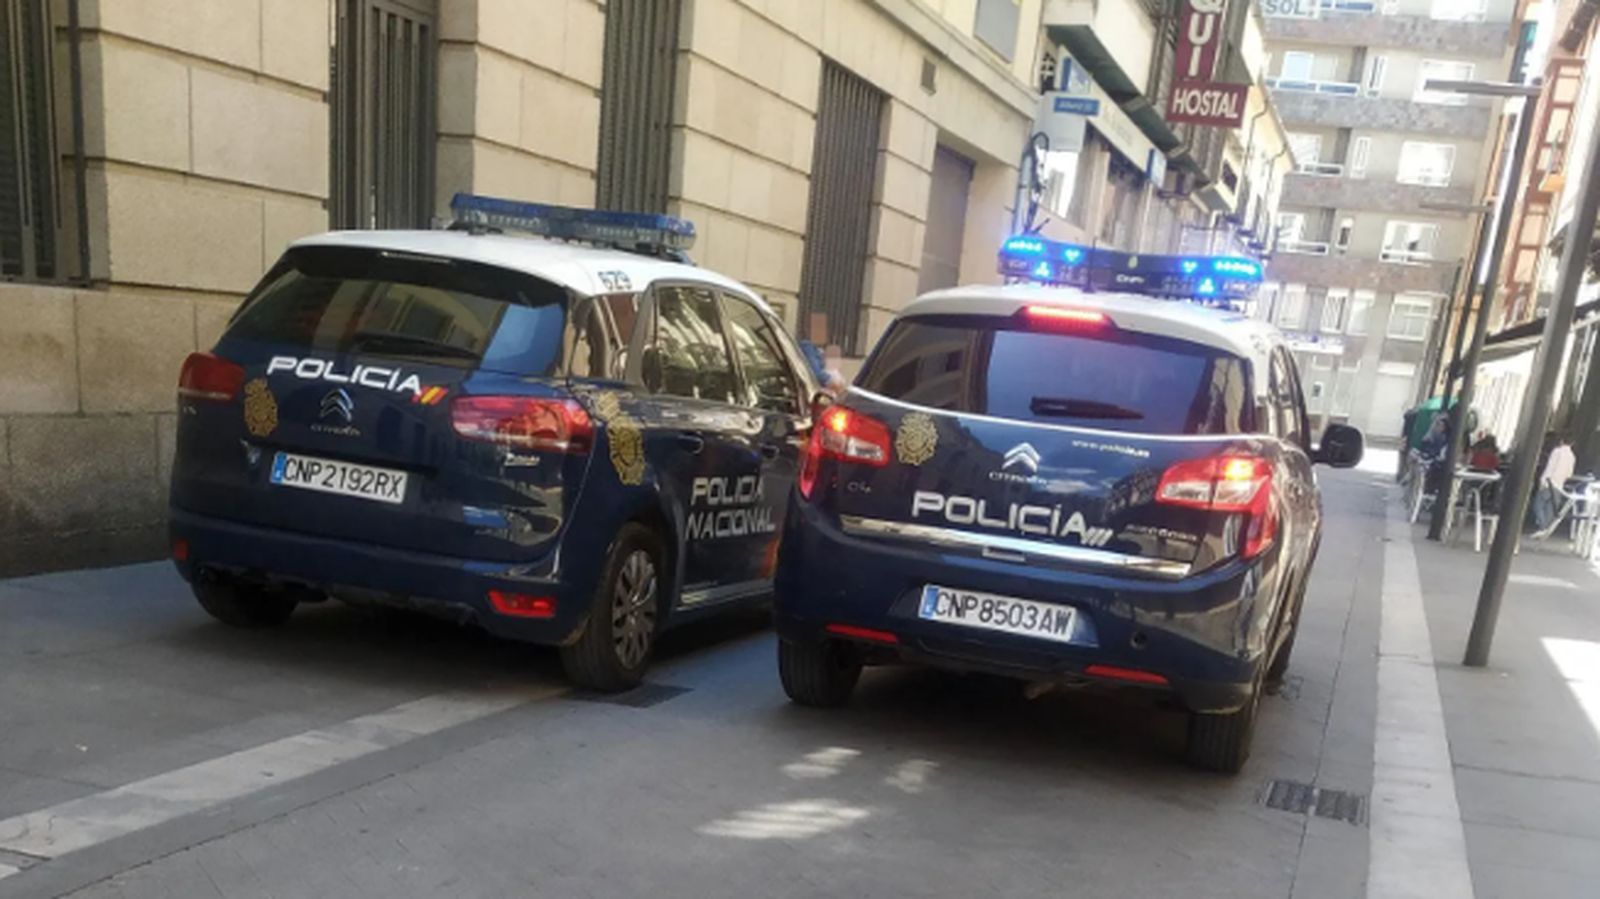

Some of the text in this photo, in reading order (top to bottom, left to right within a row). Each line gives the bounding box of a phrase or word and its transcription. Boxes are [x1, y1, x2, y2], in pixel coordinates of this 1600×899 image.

[1172, 88, 1238, 119] HOSTAL
[267, 355, 422, 396] POLICÍA
[685, 508, 777, 541] NACIONAL
[912, 490, 1088, 541] POLICÍA
